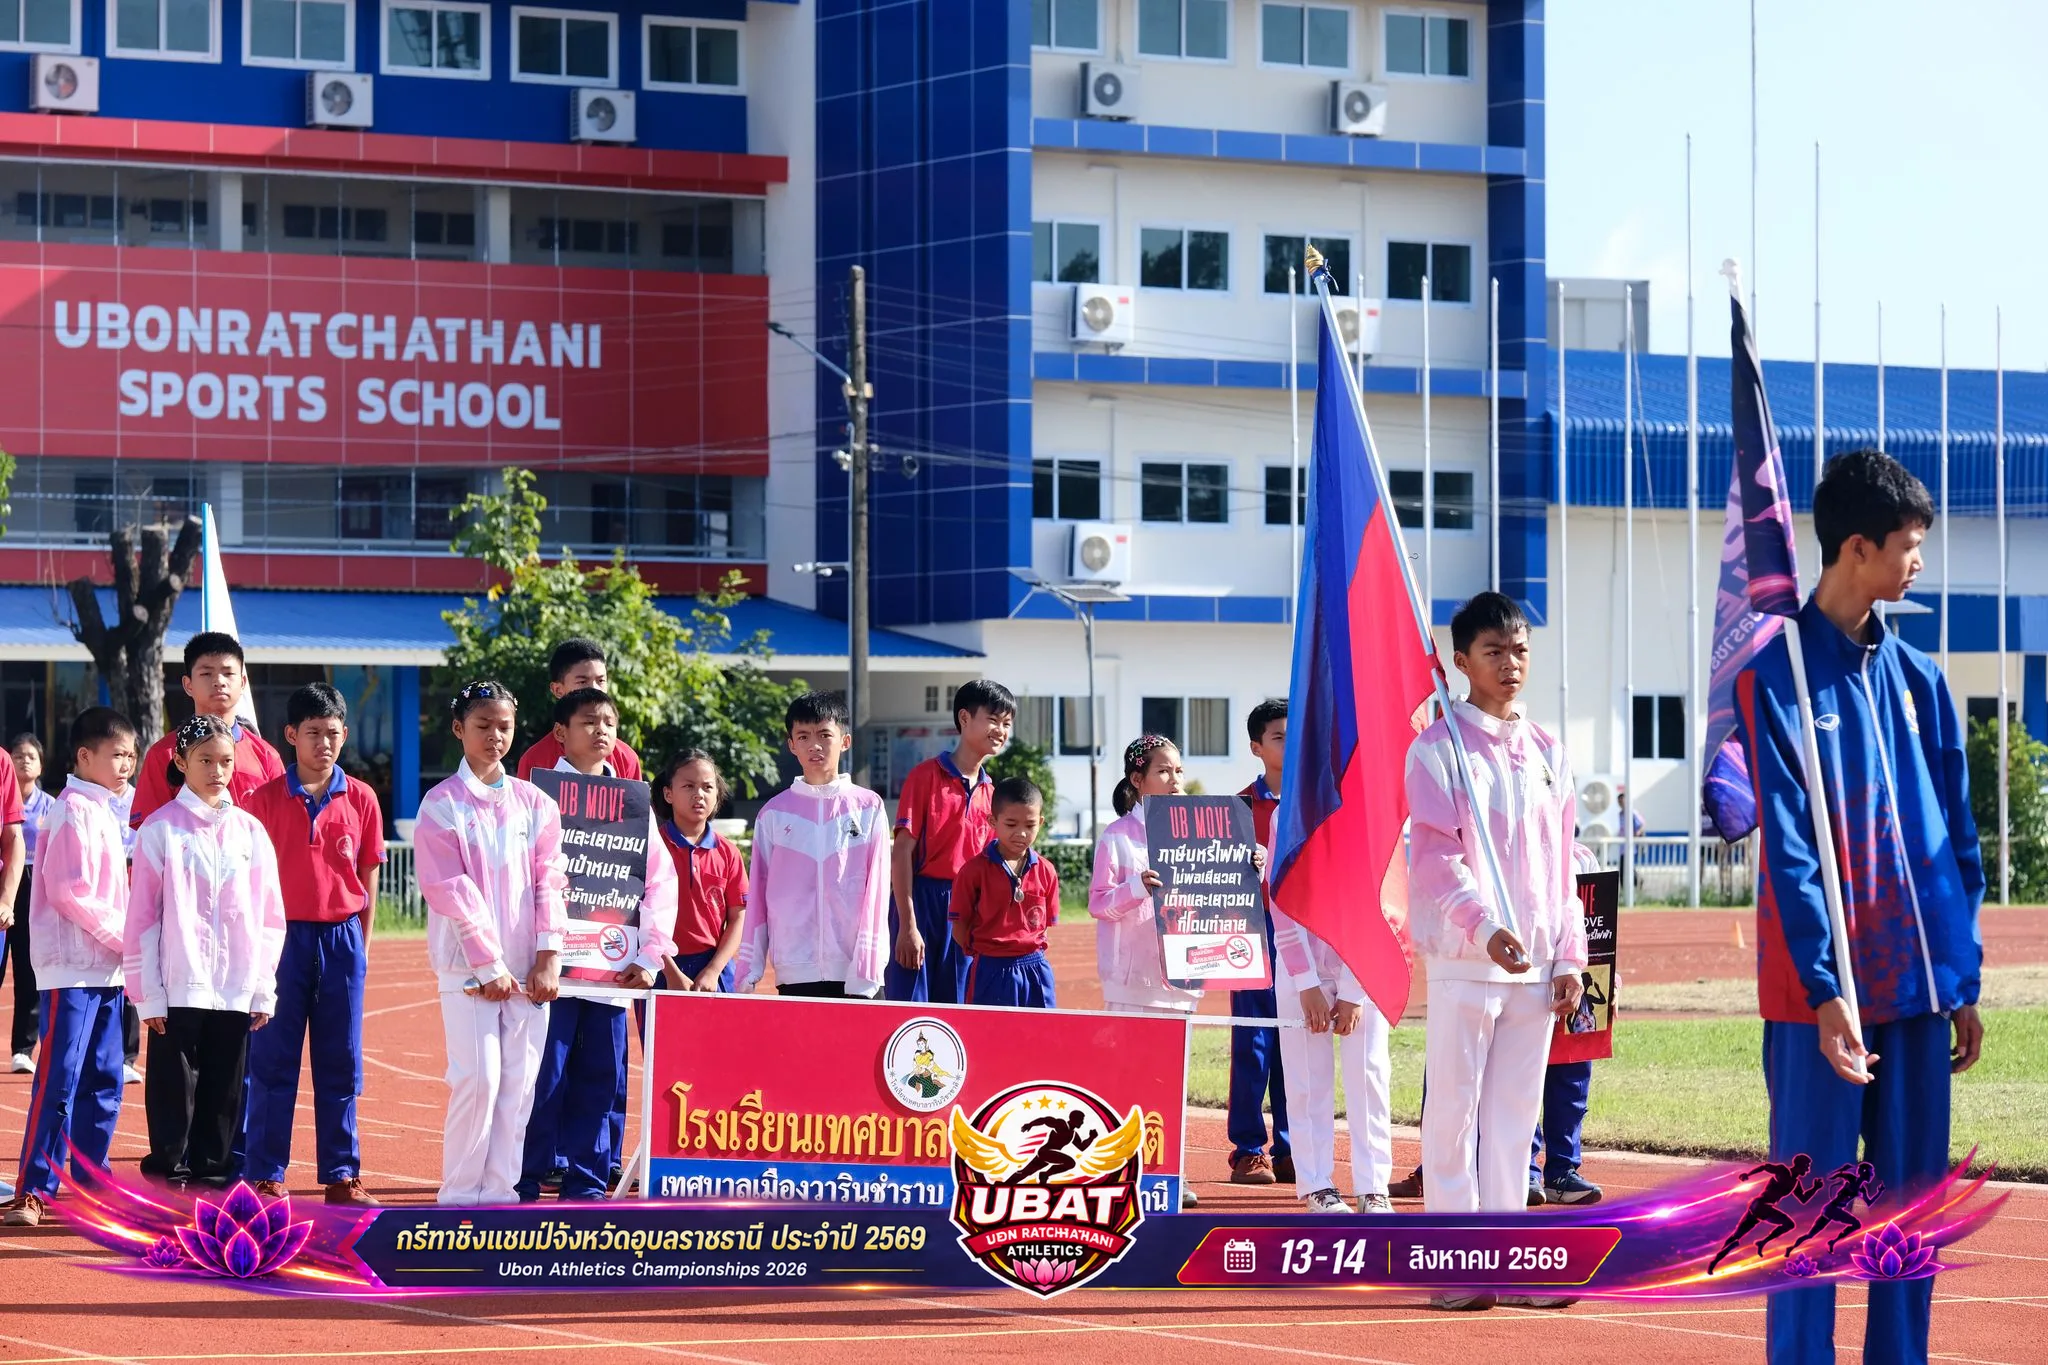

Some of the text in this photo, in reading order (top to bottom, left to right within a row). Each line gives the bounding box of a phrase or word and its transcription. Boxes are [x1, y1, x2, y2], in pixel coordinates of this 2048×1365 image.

[54, 300, 602, 369] UBONRATCHATHANI
[118, 368, 562, 431] SPORTS SCHOOL
[560, 781, 625, 822] UB MOVE
[1169, 806, 1233, 839] UB MOVE
[1164, 887, 1255, 909] เด็กและเยาวชน
